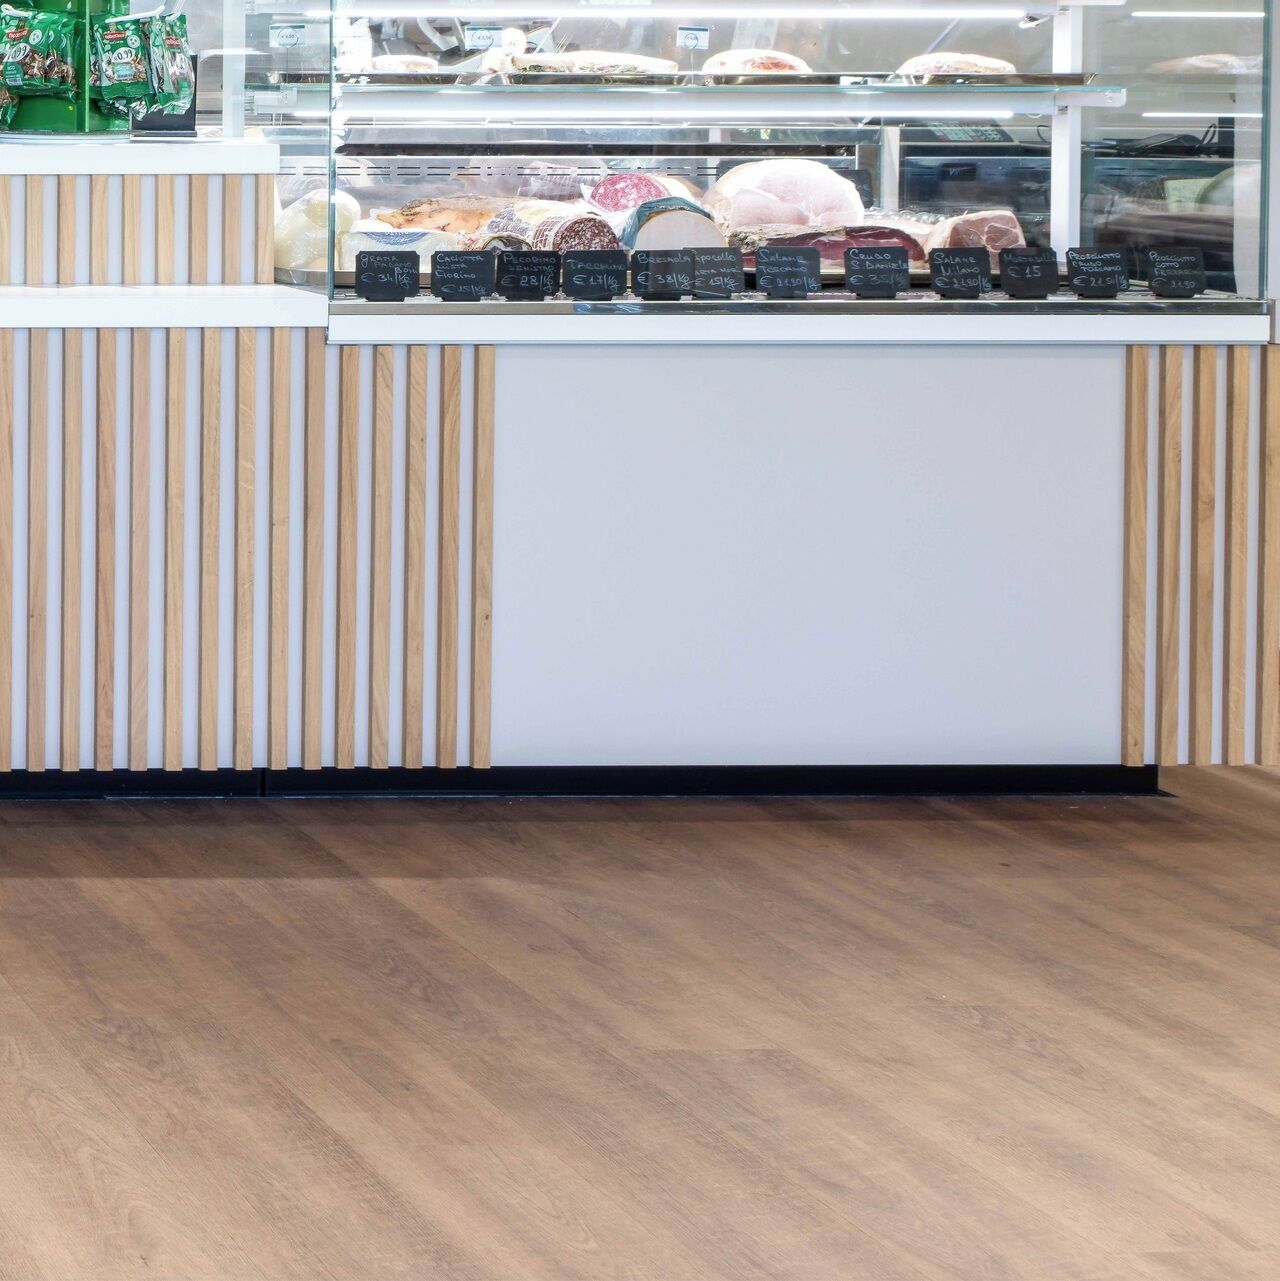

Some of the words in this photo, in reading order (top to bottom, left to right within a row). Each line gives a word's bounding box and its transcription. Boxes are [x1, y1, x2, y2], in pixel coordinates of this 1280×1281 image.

[637, 271, 652, 285] €
[1007, 266, 1022, 277] €
[1025, 265, 1041, 278] 15
[572, 274, 587, 286] €
[759, 275, 774, 288] €
